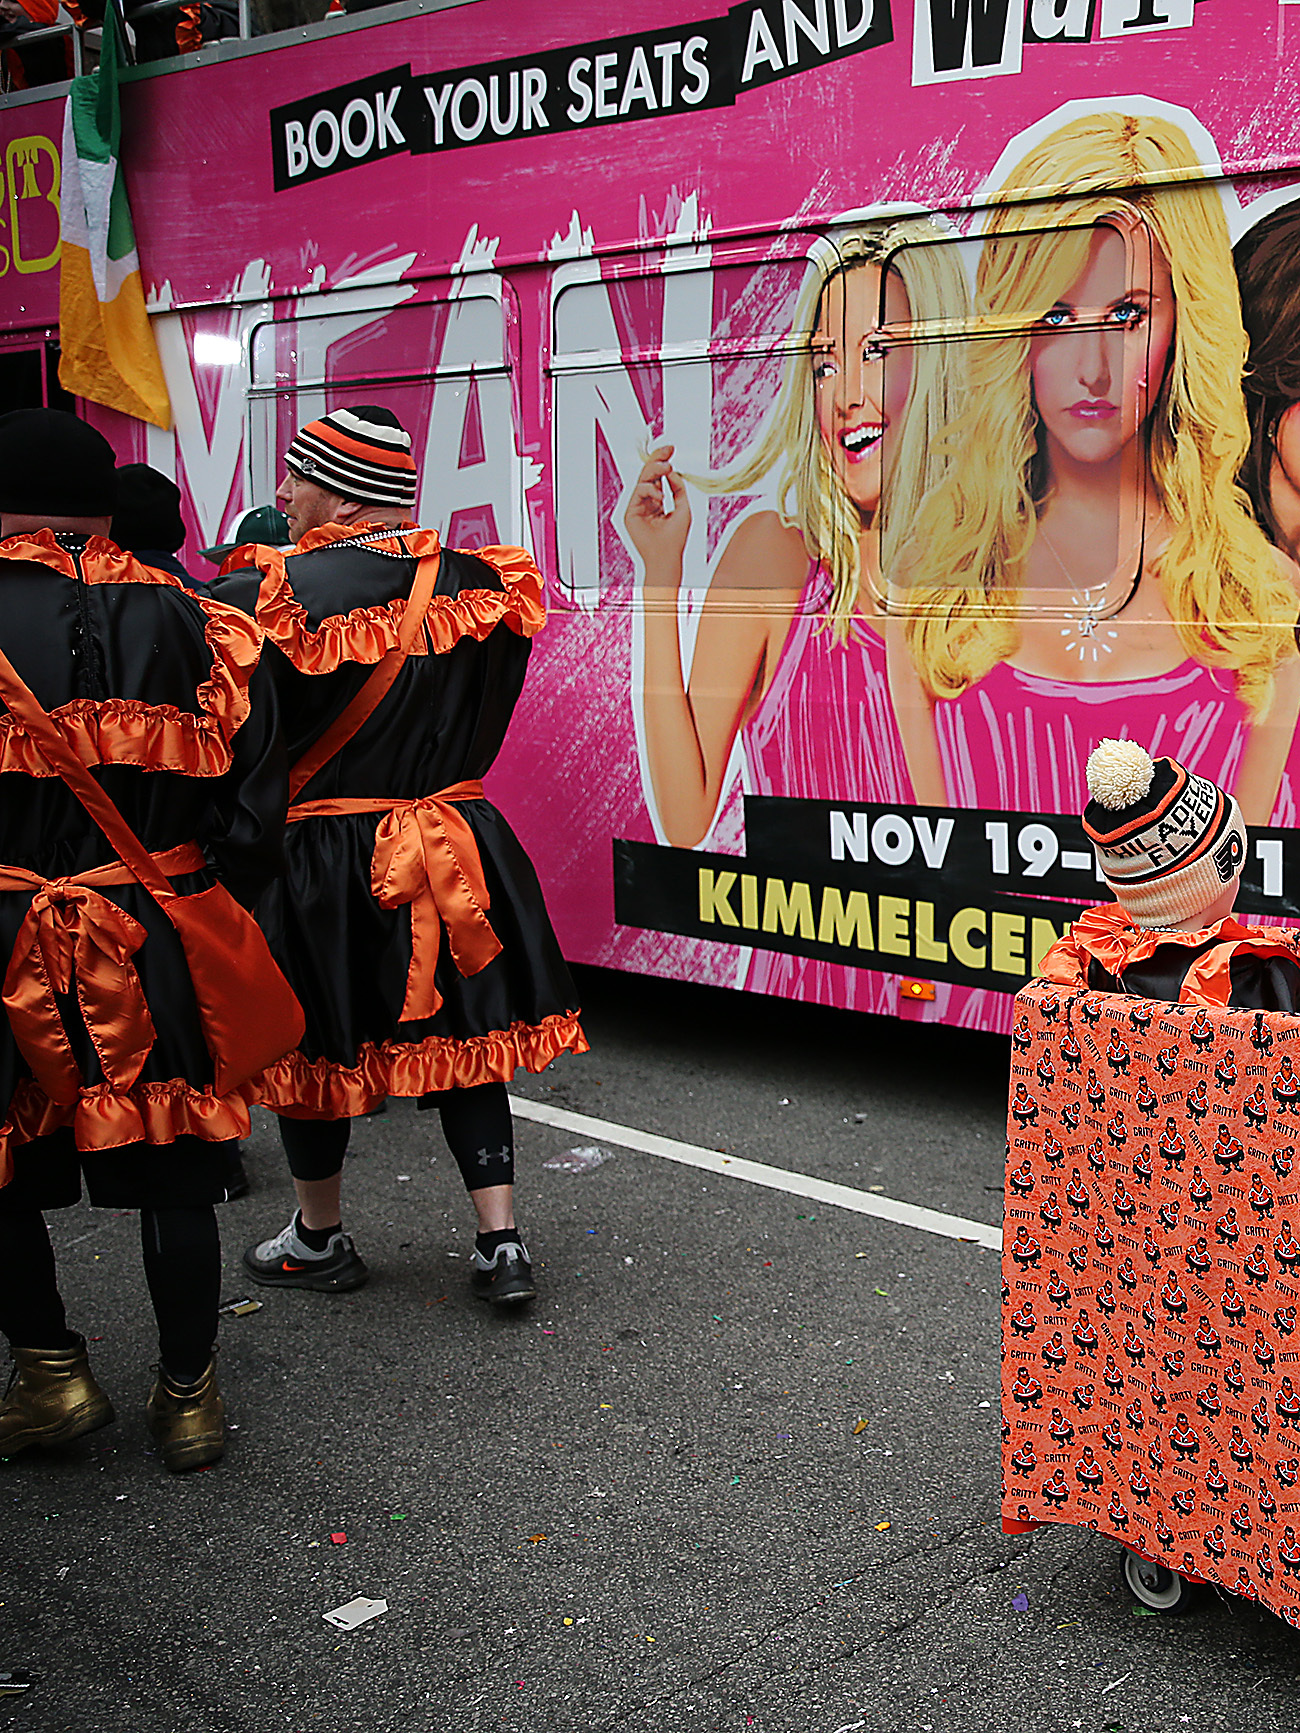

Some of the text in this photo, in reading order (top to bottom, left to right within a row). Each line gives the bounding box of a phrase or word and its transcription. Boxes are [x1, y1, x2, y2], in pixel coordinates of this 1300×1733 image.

[284, 0, 876, 178] BOOK YOUR SEATS AND
[1148, 781, 1214, 868] FLYERS
[829, 809, 956, 870] NOV
[985, 821, 1104, 884] 19-
[1106, 1008, 1125, 1022] GRITTY
[1037, 1031, 1055, 1041] GRITTY
[1159, 1021, 1182, 1038] GRITTY
[1220, 1024, 1245, 1040] GRITTY
[1277, 1028, 1299, 1042] GRITTY
[1084, 1034, 1102, 1062] GRITTY
[1134, 1051, 1152, 1064] GRITTY
[1184, 1059, 1208, 1074] GRITTY
[1063, 1078, 1082, 1096] GRITTY
[1110, 1087, 1132, 1103] GRITTY
[1162, 1091, 1183, 1104] GRITTY
[1213, 1104, 1238, 1118] GRITTY
[1273, 1120, 1299, 1139] GRITTY
[1015, 1139, 1040, 1152] GRITTY
[1067, 1144, 1085, 1156] GRITTY
[1189, 1130, 1208, 1159] GRITTY
[1248, 1147, 1268, 1162] GRITTY
[1109, 1160, 1129, 1174] GRITTY
[1041, 1175, 1061, 1185] GRITTY
[1161, 1176, 1183, 1195] GRITTY
[1092, 1181, 1109, 1209] GRITTY
[1218, 1184, 1245, 1200] GRITTY
[1277, 1193, 1298, 1206] GRITTY
[1010, 1209, 1035, 1220] GRITTY
[1069, 1222, 1089, 1240] GRITTY
[1184, 1215, 1207, 1231] GRITTY
[1245, 1226, 1269, 1238] GRITTY
[1118, 1234, 1139, 1250] GRITTY
[1045, 1246, 1064, 1260] GRITTY
[1164, 1246, 1183, 1257] GRITTY
[1093, 1258, 1112, 1275] GRITTY
[1217, 1258, 1240, 1273] GRITTY
[1016, 1281, 1042, 1294] GRITTY
[1074, 1286, 1093, 1297] GRITTY
[1275, 1280, 1298, 1300] GRITTY
[1191, 1284, 1216, 1310] GRITTY
[1120, 1302, 1139, 1318] GRITTY
[1250, 1304, 1270, 1320] GRITTY
[1044, 1316, 1067, 1325] GRITTY
[1101, 1323, 1119, 1350] GRITTY
[1164, 1326, 1186, 1344] GRITTY
[1225, 1335, 1248, 1353] GRITTY
[1011, 1350, 1036, 1361] GRITTY
[1279, 1352, 1299, 1362] GRITTY
[1075, 1361, 1096, 1379] GRITTY
[1191, 1362, 1218, 1377] GRITTY
[1047, 1385, 1068, 1398] GRITTY
[1128, 1375, 1147, 1392] GRITTY
[1251, 1377, 1271, 1392] GRITTY
[1170, 1391, 1193, 1402] GRITTY
[1100, 1397, 1121, 1414] GRITTY
[1225, 1406, 1247, 1422] GRITTY
[1016, 1420, 1043, 1432] GRITTY
[1078, 1424, 1099, 1435] GRITTY
[1203, 1426, 1224, 1453] GRITTY
[1277, 1433, 1300, 1453] GRITTY
[1045, 1454, 1070, 1463] GRITTY
[1106, 1460, 1125, 1487] GRITTY
[1173, 1466, 1198, 1484] GRITTY
[1011, 1488, 1037, 1499] GRITTY
[1233, 1480, 1255, 1498] GRITTY
[1077, 1497, 1101, 1514] GRITTY
[1201, 1502, 1225, 1520] GRITTY
[1133, 1512, 1152, 1530] GRITTY
[1178, 1530, 1201, 1540] GRITTY
[1231, 1548, 1254, 1564] GRITTY
